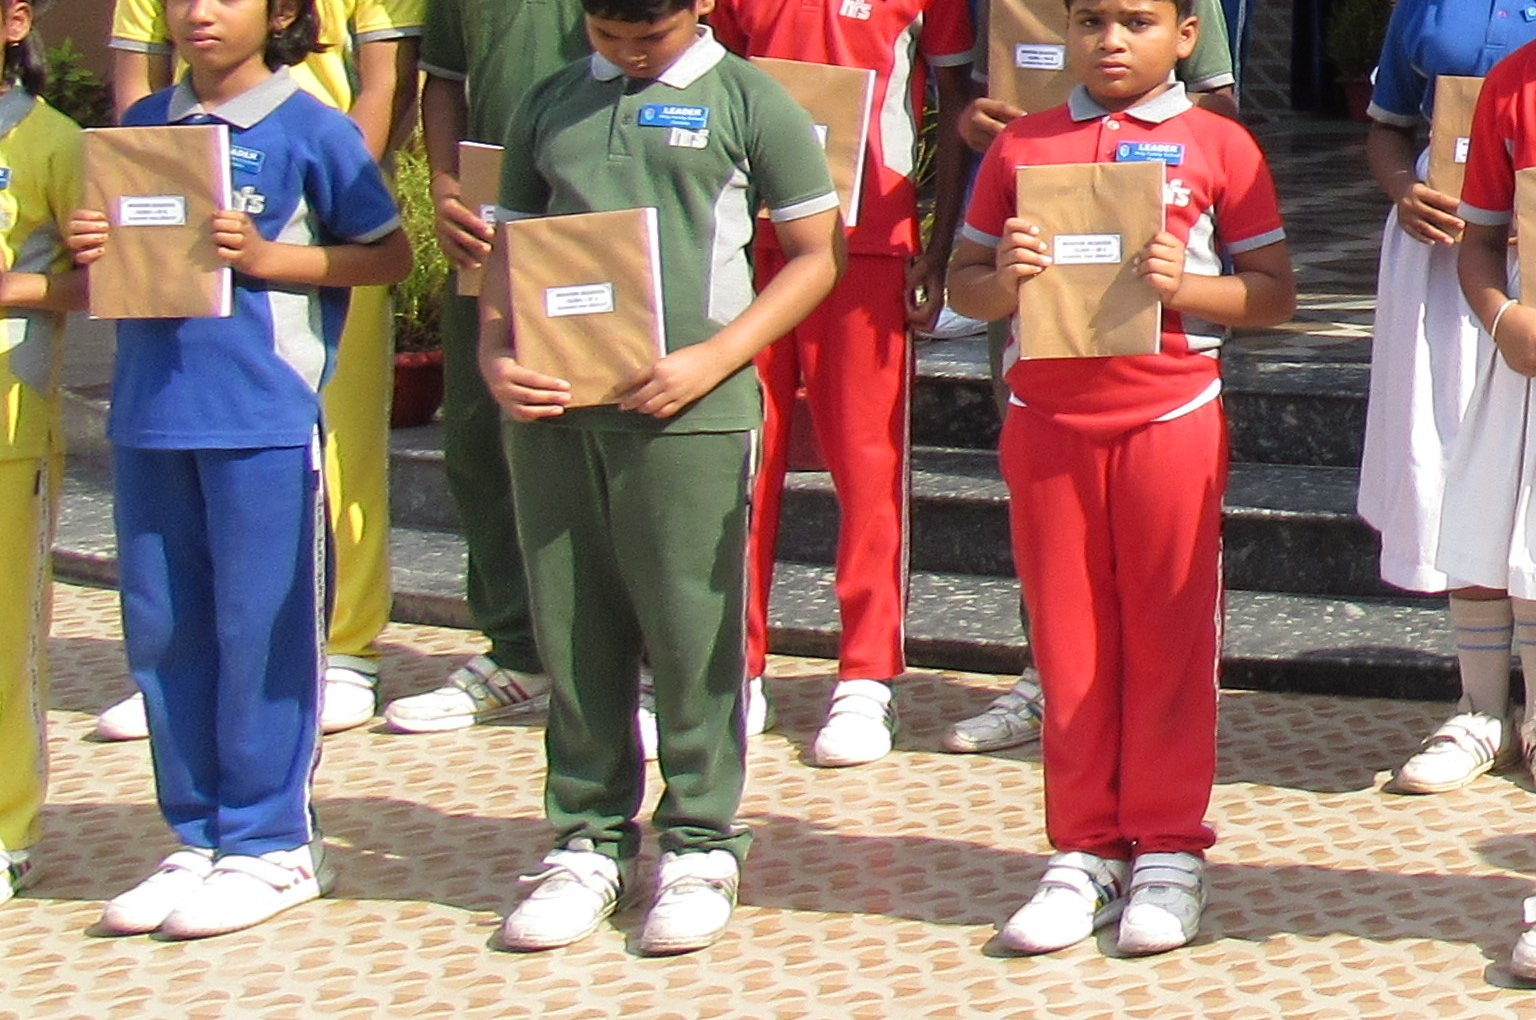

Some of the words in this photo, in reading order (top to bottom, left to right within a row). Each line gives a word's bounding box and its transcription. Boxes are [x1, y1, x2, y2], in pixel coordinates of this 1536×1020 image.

[663, 106, 703, 116] LEADER
[1138, 143, 1179, 153] LEADER
[230, 147, 259, 160] ADER
